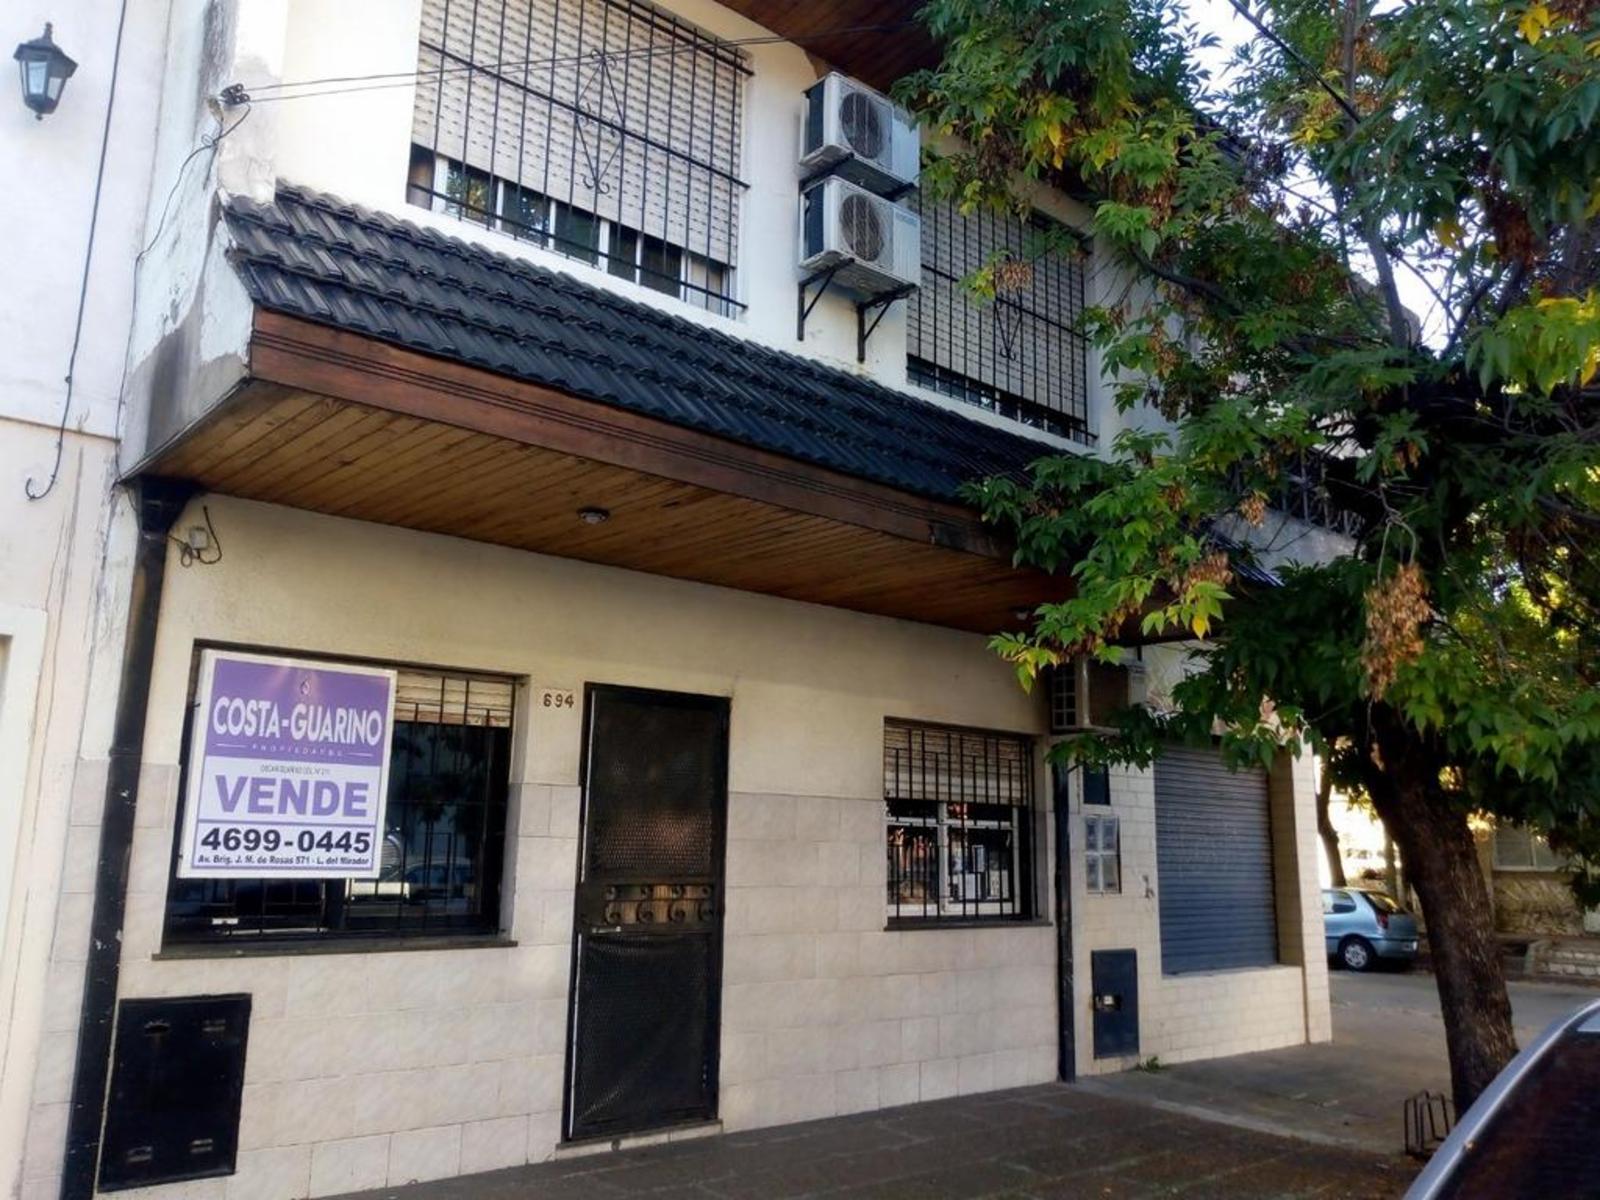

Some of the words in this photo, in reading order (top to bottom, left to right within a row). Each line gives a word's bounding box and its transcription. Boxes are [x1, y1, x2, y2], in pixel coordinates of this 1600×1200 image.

[543, 693, 574, 708] 694
[213, 696, 382, 745] COSTA-GUARINO
[215, 775, 368, 817] VENDE
[201, 827, 370, 853] 4699-0445
